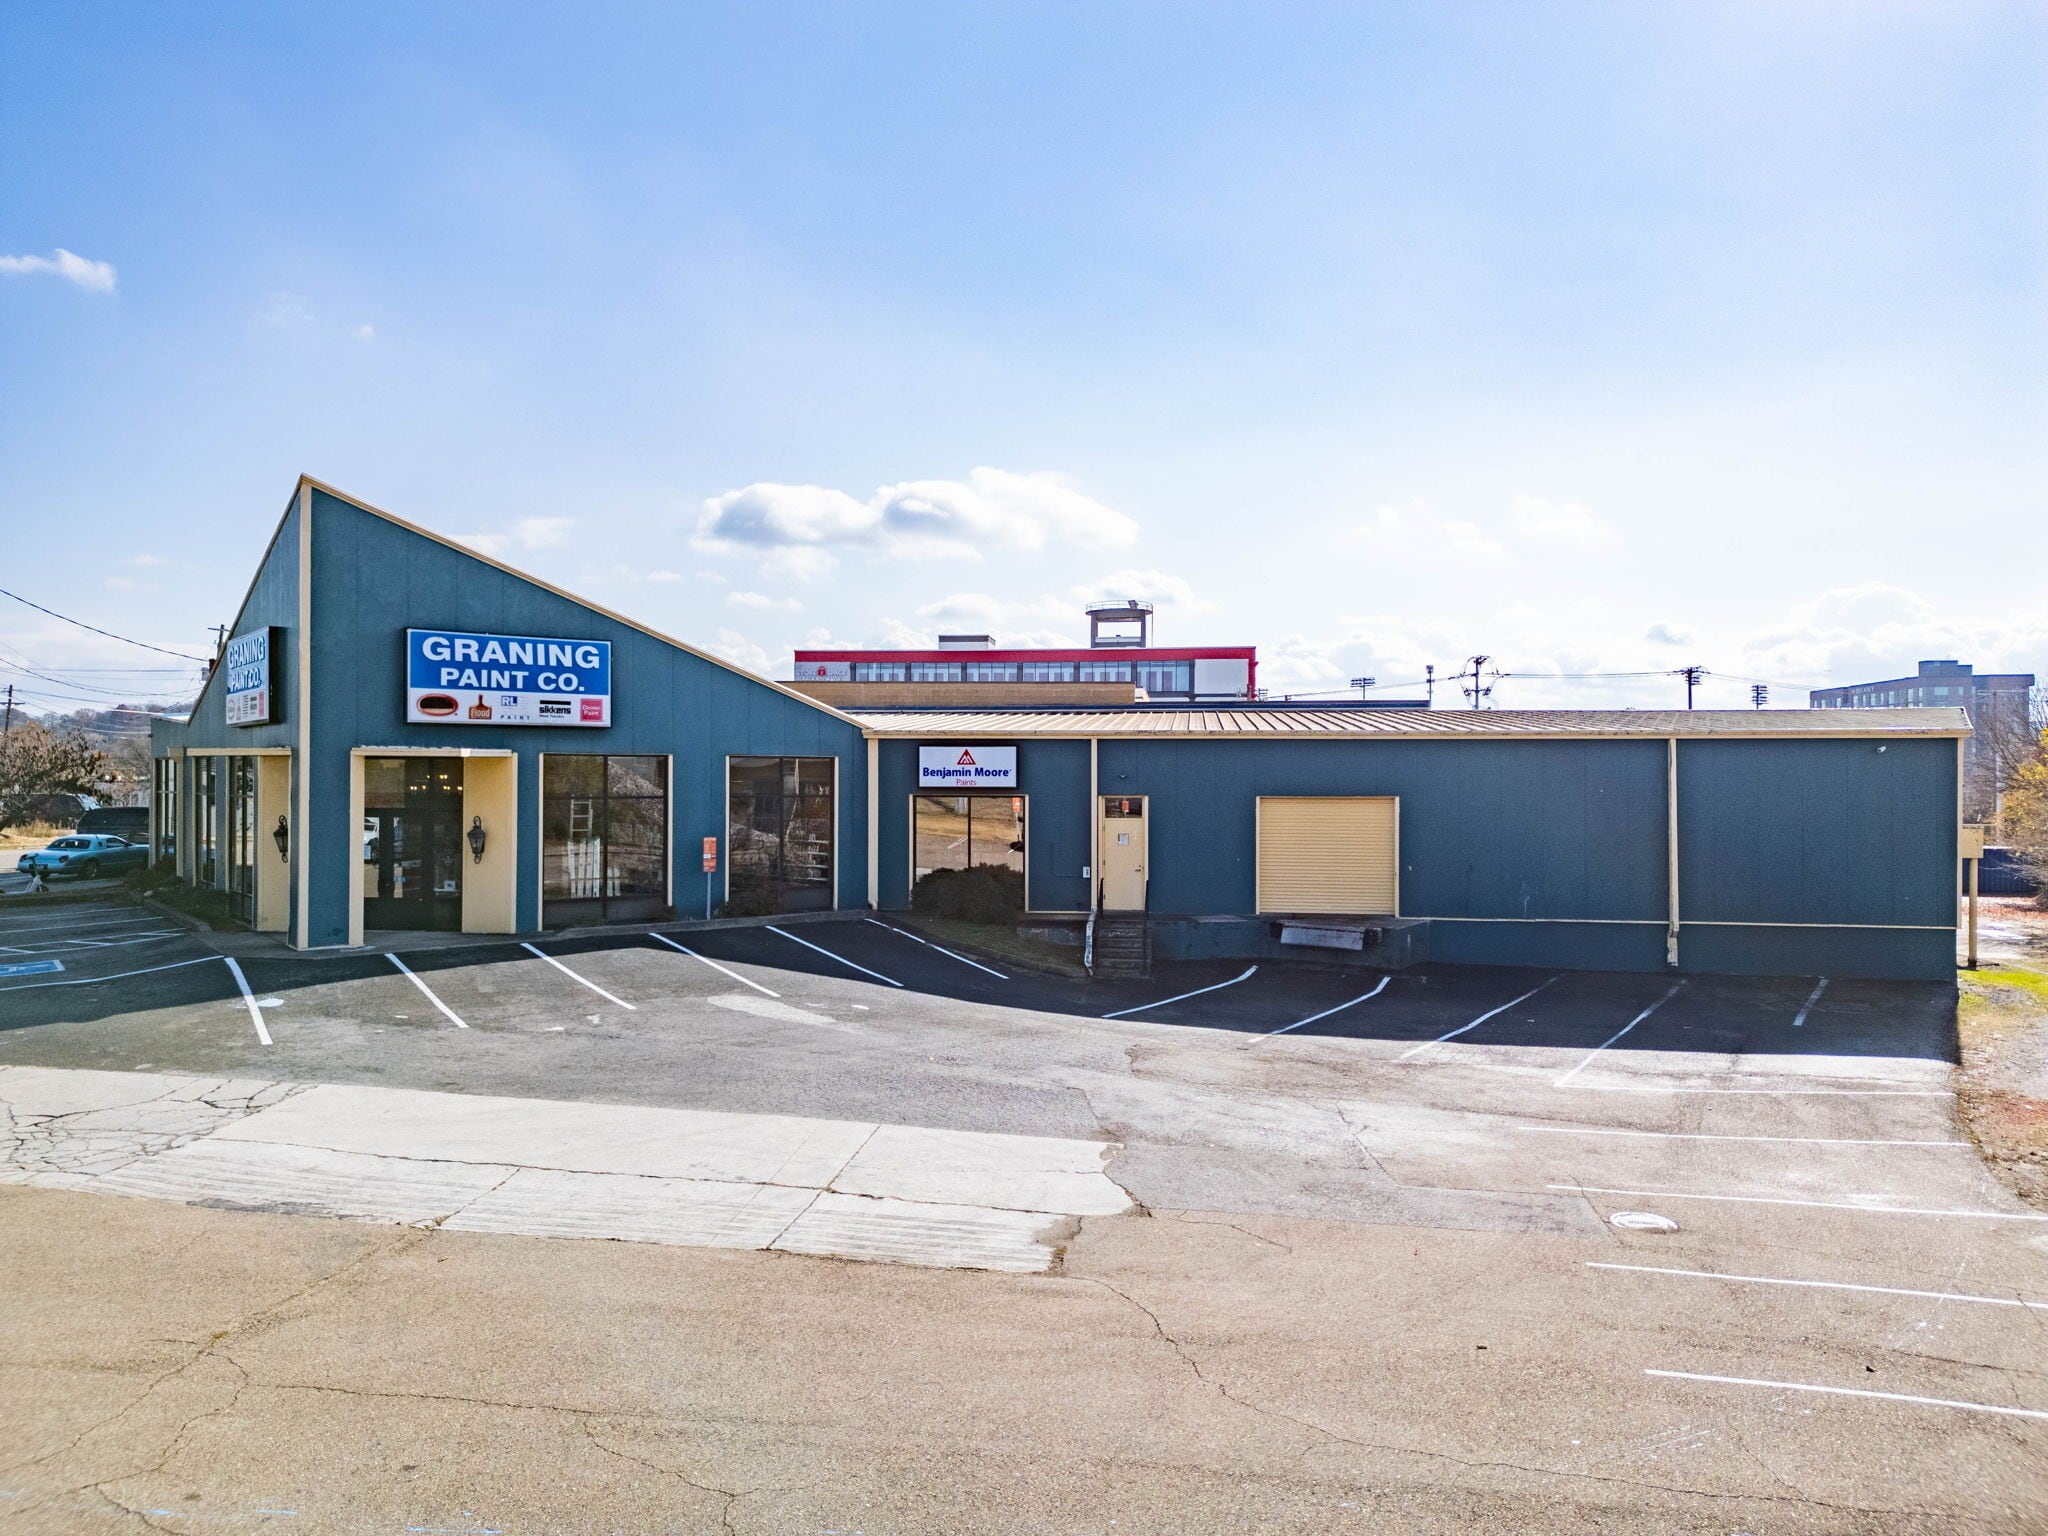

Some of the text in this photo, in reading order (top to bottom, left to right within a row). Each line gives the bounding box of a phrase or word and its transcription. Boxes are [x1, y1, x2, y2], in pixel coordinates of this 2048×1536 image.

[229, 636, 265, 670] GRANING
[422, 636, 600, 669] GRANING
[231, 670, 249, 693] PAINT
[440, 667, 585, 692] PAINT CO.
[502, 696, 517, 706] RL
[539, 705, 571, 715] sikkens
[922, 767, 1010, 779] Benjamin Moore
